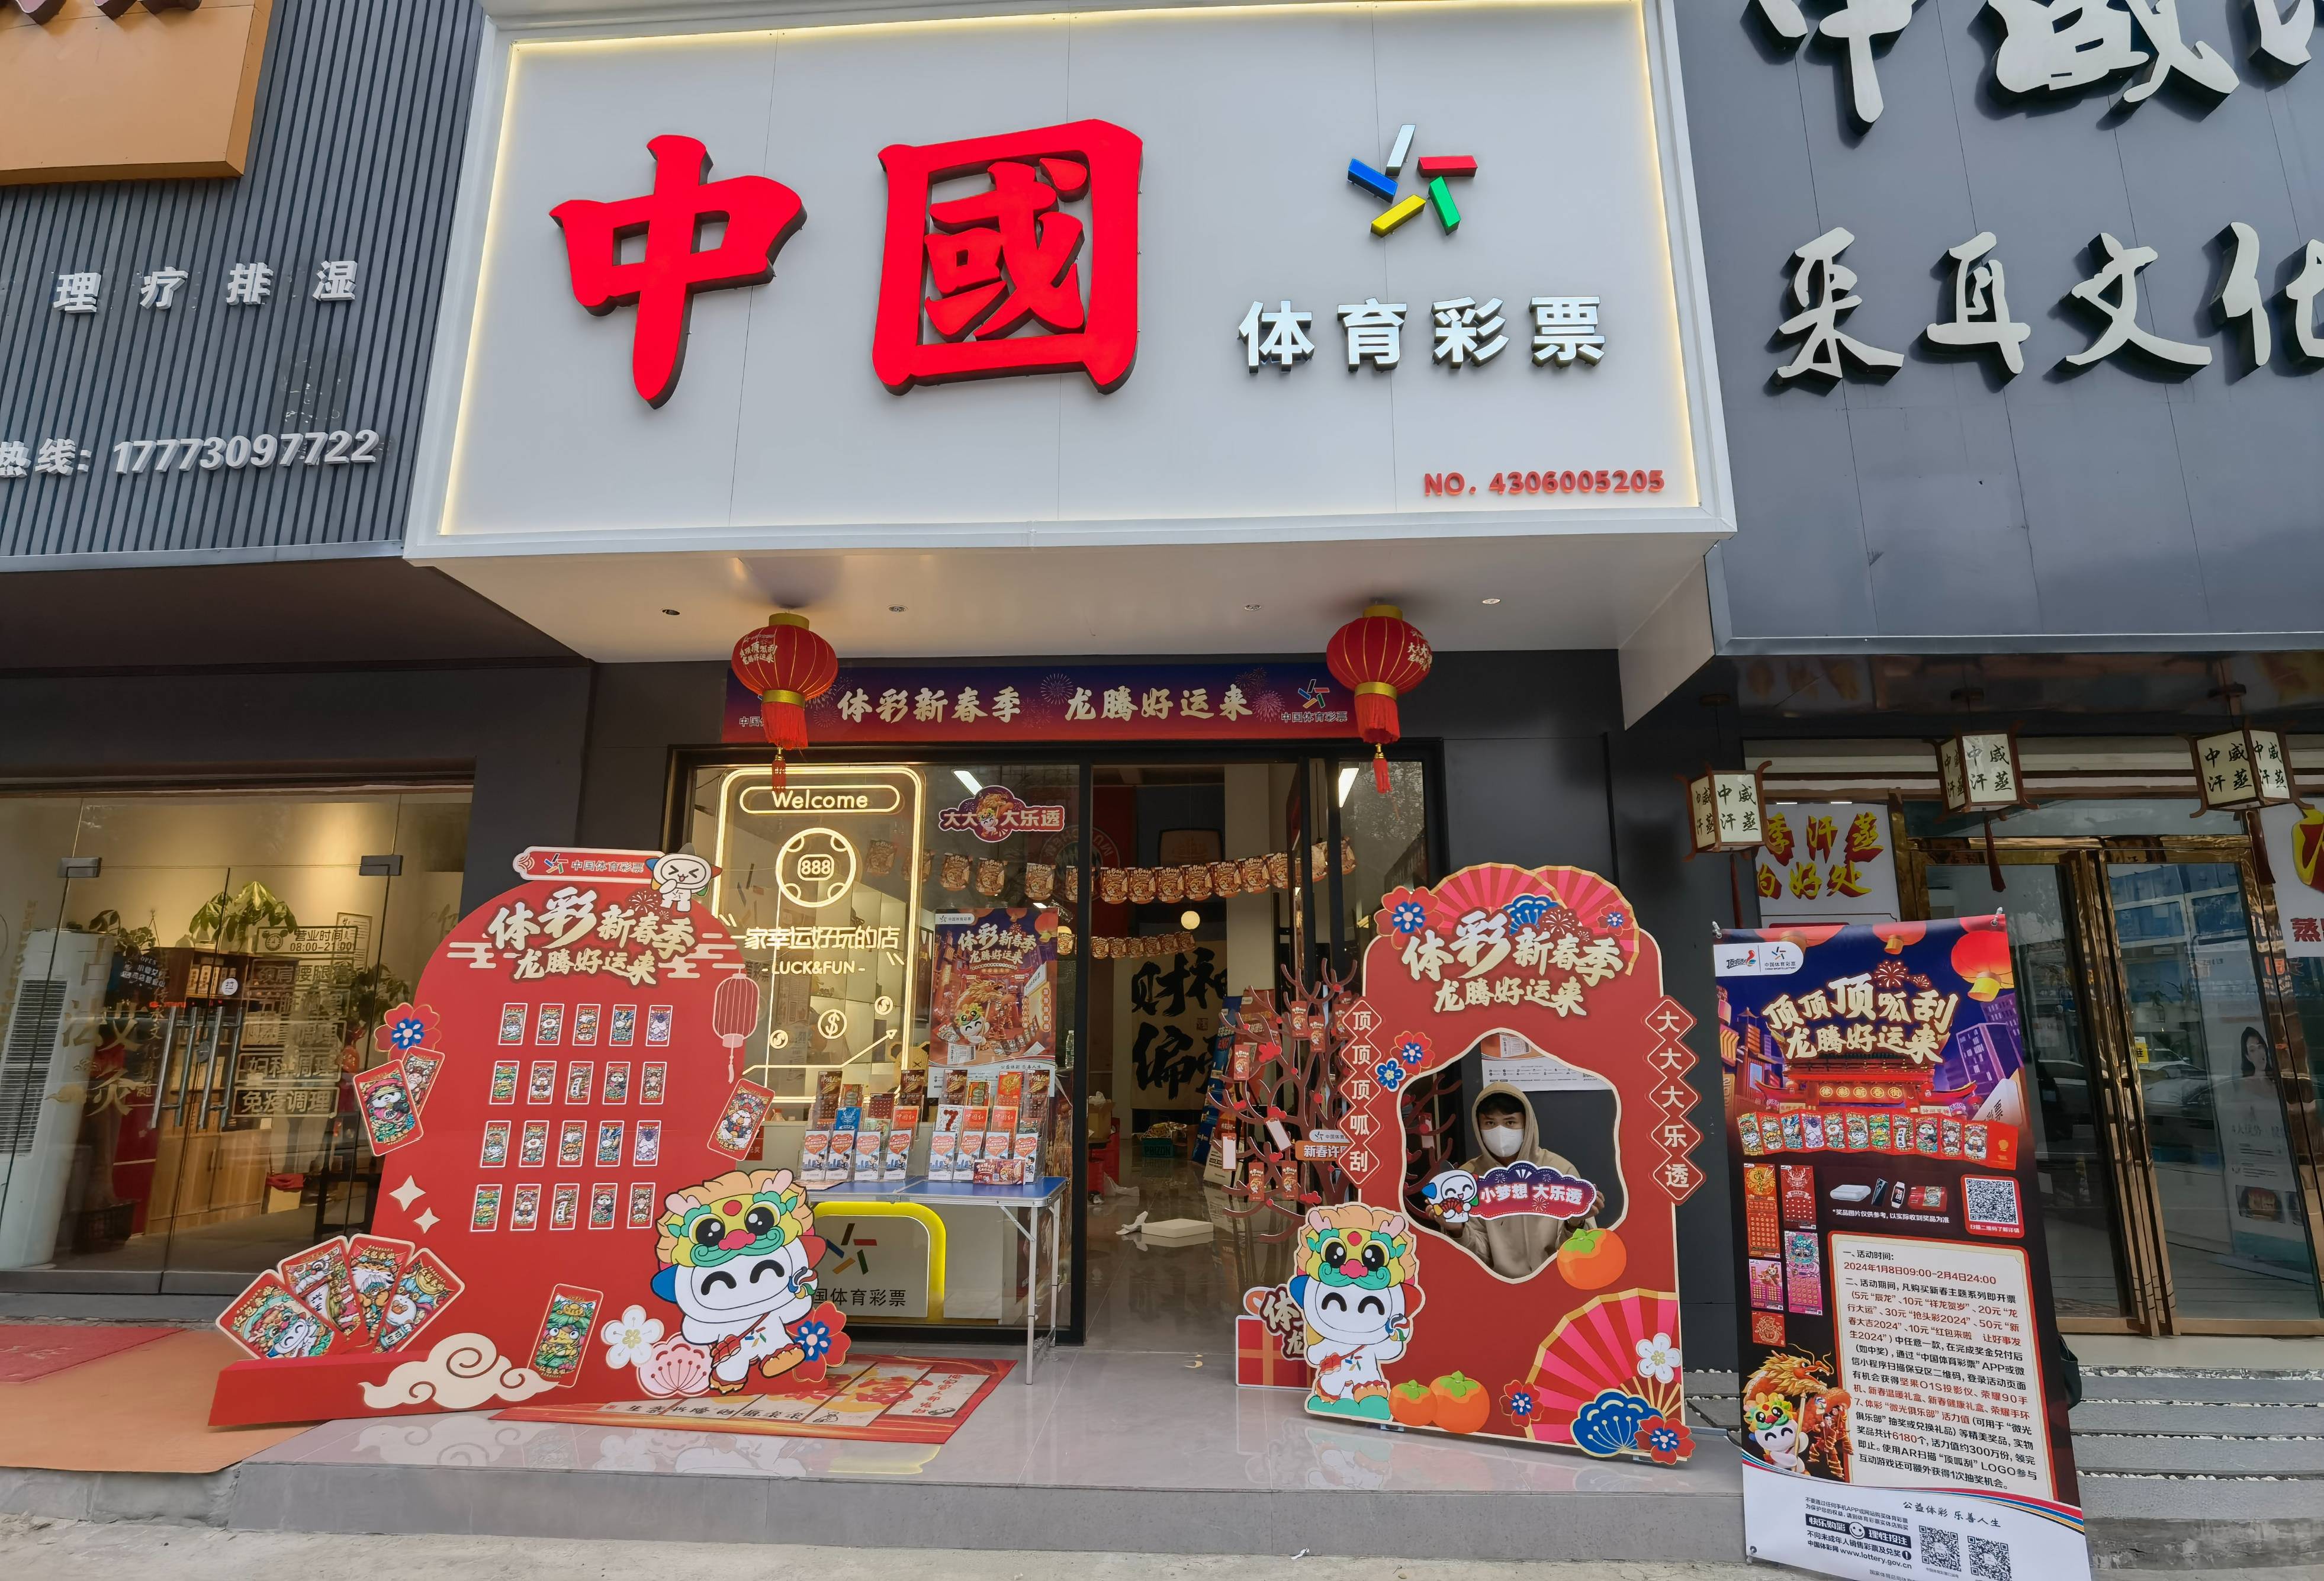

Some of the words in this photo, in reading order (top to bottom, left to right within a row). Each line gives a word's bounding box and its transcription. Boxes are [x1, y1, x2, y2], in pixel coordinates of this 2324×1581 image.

[549, 118, 1143, 409] 中國
[52, 259, 358, 314] 理疗排湿
[1238, 295, 1607, 372] 体育彩票
[114, 429, 379, 474] 17773097722
[1489, 469, 1665, 493] 4306005205
[740, 716, 764, 727] 中国
[837, 686, 1021, 724] 体彩新春季
[1065, 683, 1253, 722] 龙腾好运来
[1281, 711, 1348, 724] 中国体育彩票
[1970, 772, 2012, 792] 汗蒸
[772, 789, 869, 810] Welcome
[1001, 809, 1060, 828] 大乐透
[1721, 811, 1758, 831] 汗蒸
[571, 859, 645, 874] 中国体育彩票
[800, 858, 832, 876] 888
[295, 930, 343, 942] 营业时间
[488, 886, 696, 960] 体彩新春季
[731, 925, 901, 950] 一家幸运好玩的店
[957, 923, 1037, 953] 体彩新春季
[2290, 917, 2324, 942] 蒸
[968, 949, 1024, 965] 龙腾好运来
[1402, 910, 1624, 987] 体彩新春季
[513, 948, 657, 986] 龙腾好运来
[772, 960, 856, 975] LUCK&FUN
[1433, 976, 1587, 1018] 龙腾好运来
[1762, 972, 1959, 1034] 顶顶顶呱刮
[1786, 1023, 1944, 1065] 龙腾好运来
[242, 1091, 331, 1113] 免疫调理
[1349, 1011, 1372, 1173] 顶顶顶呱刮
[1657, 1010, 1690, 1188] 大大大乐透
[1480, 1184, 1528, 1203] 小梦想
[1532, 1184, 1583, 1204] 大乐透
[1844, 1262, 1997, 1285] 2024年1月8日09:00-2月4日24:00
[1265, 1292, 1304, 1328] 体
[1902, 1501, 1948, 1517] 公益体彩
[1953, 1511, 2001, 1528] 乐善人生
[1808, 1516, 1846, 1532] 快乐购彩
[1868, 1528, 1908, 1546] 理性投注
[1807, 1540, 1839, 1553] 中国体彩网
[1840, 1548, 1912, 1570] www.lottery.gov.cn
